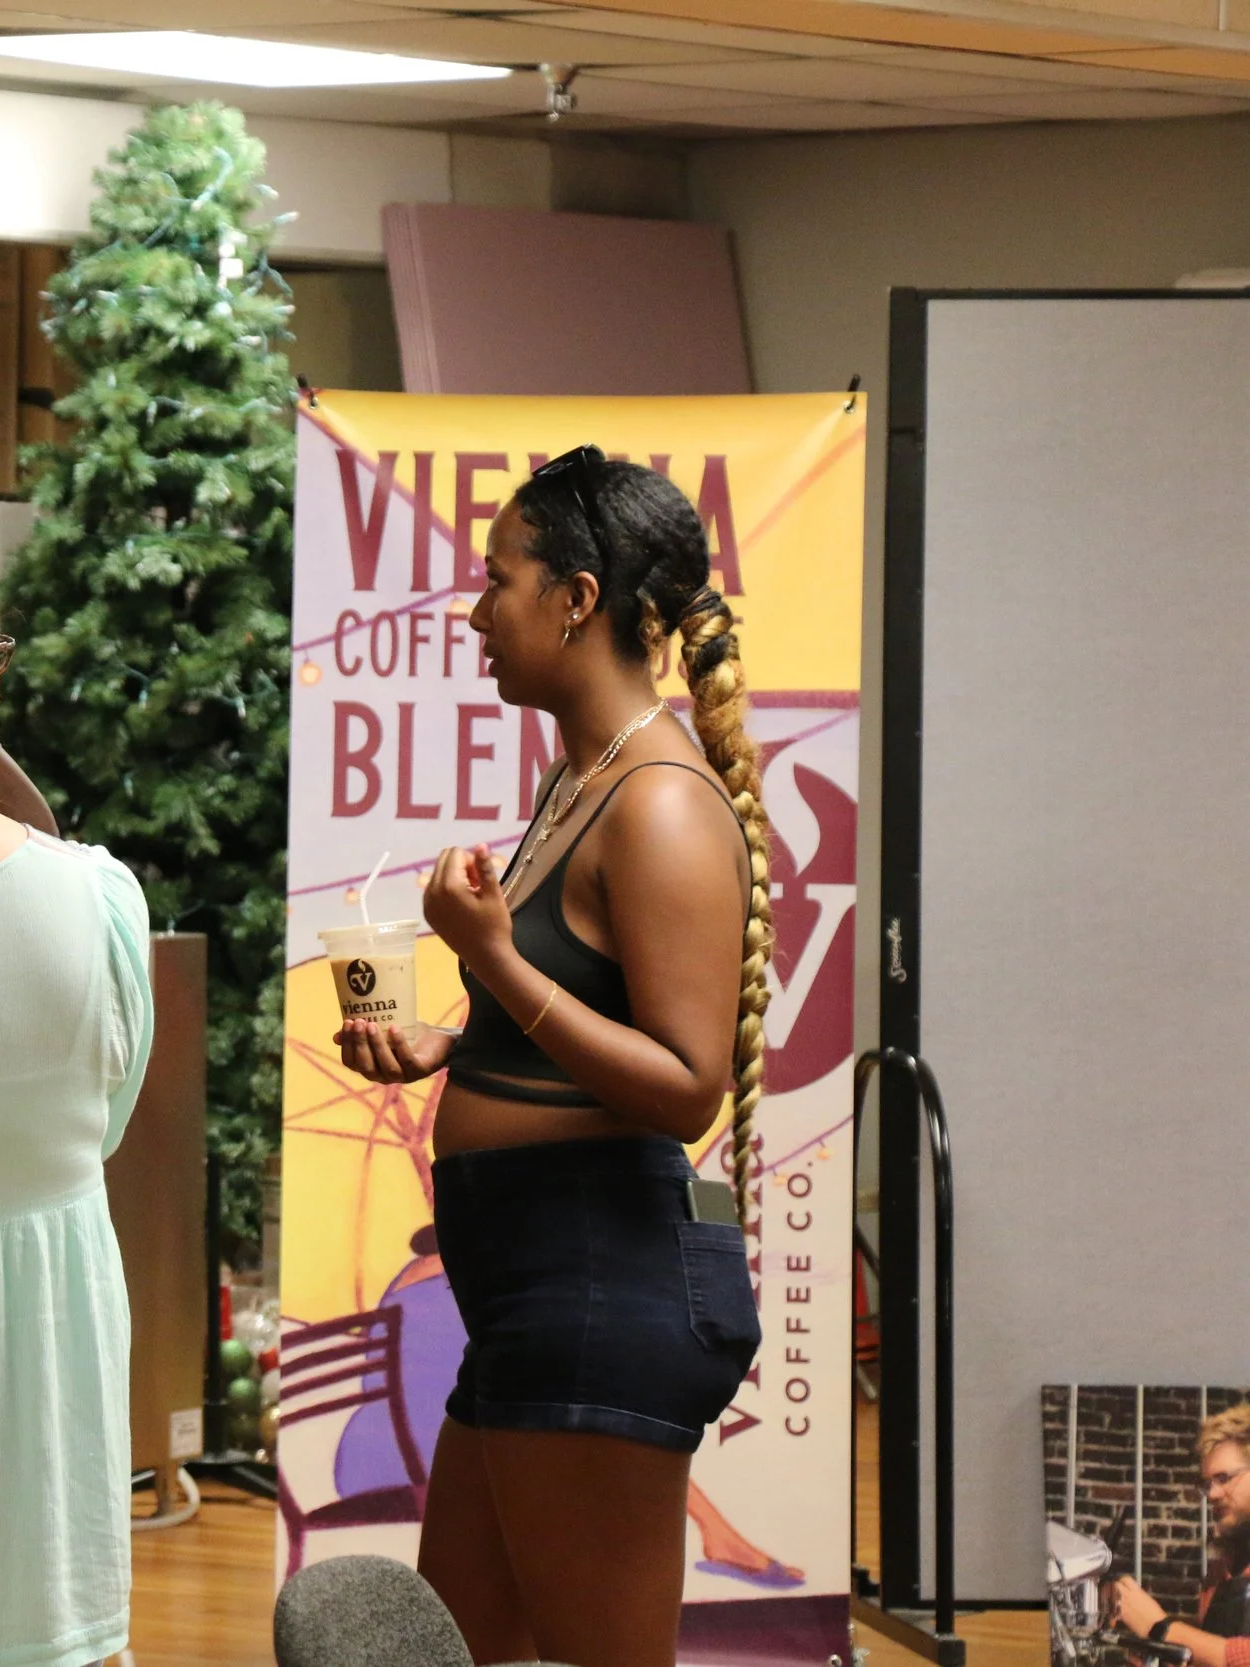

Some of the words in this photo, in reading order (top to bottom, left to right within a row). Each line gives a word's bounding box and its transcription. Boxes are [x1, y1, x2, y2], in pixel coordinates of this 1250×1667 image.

[335, 449, 746, 596] VIEA
[334, 609, 490, 678] COFF
[331, 701, 565, 821] BLEN
[342, 998, 397, 1016] vienna
[786, 1160, 814, 1232] CO.
[784, 1254, 812, 1437] COFFEE
